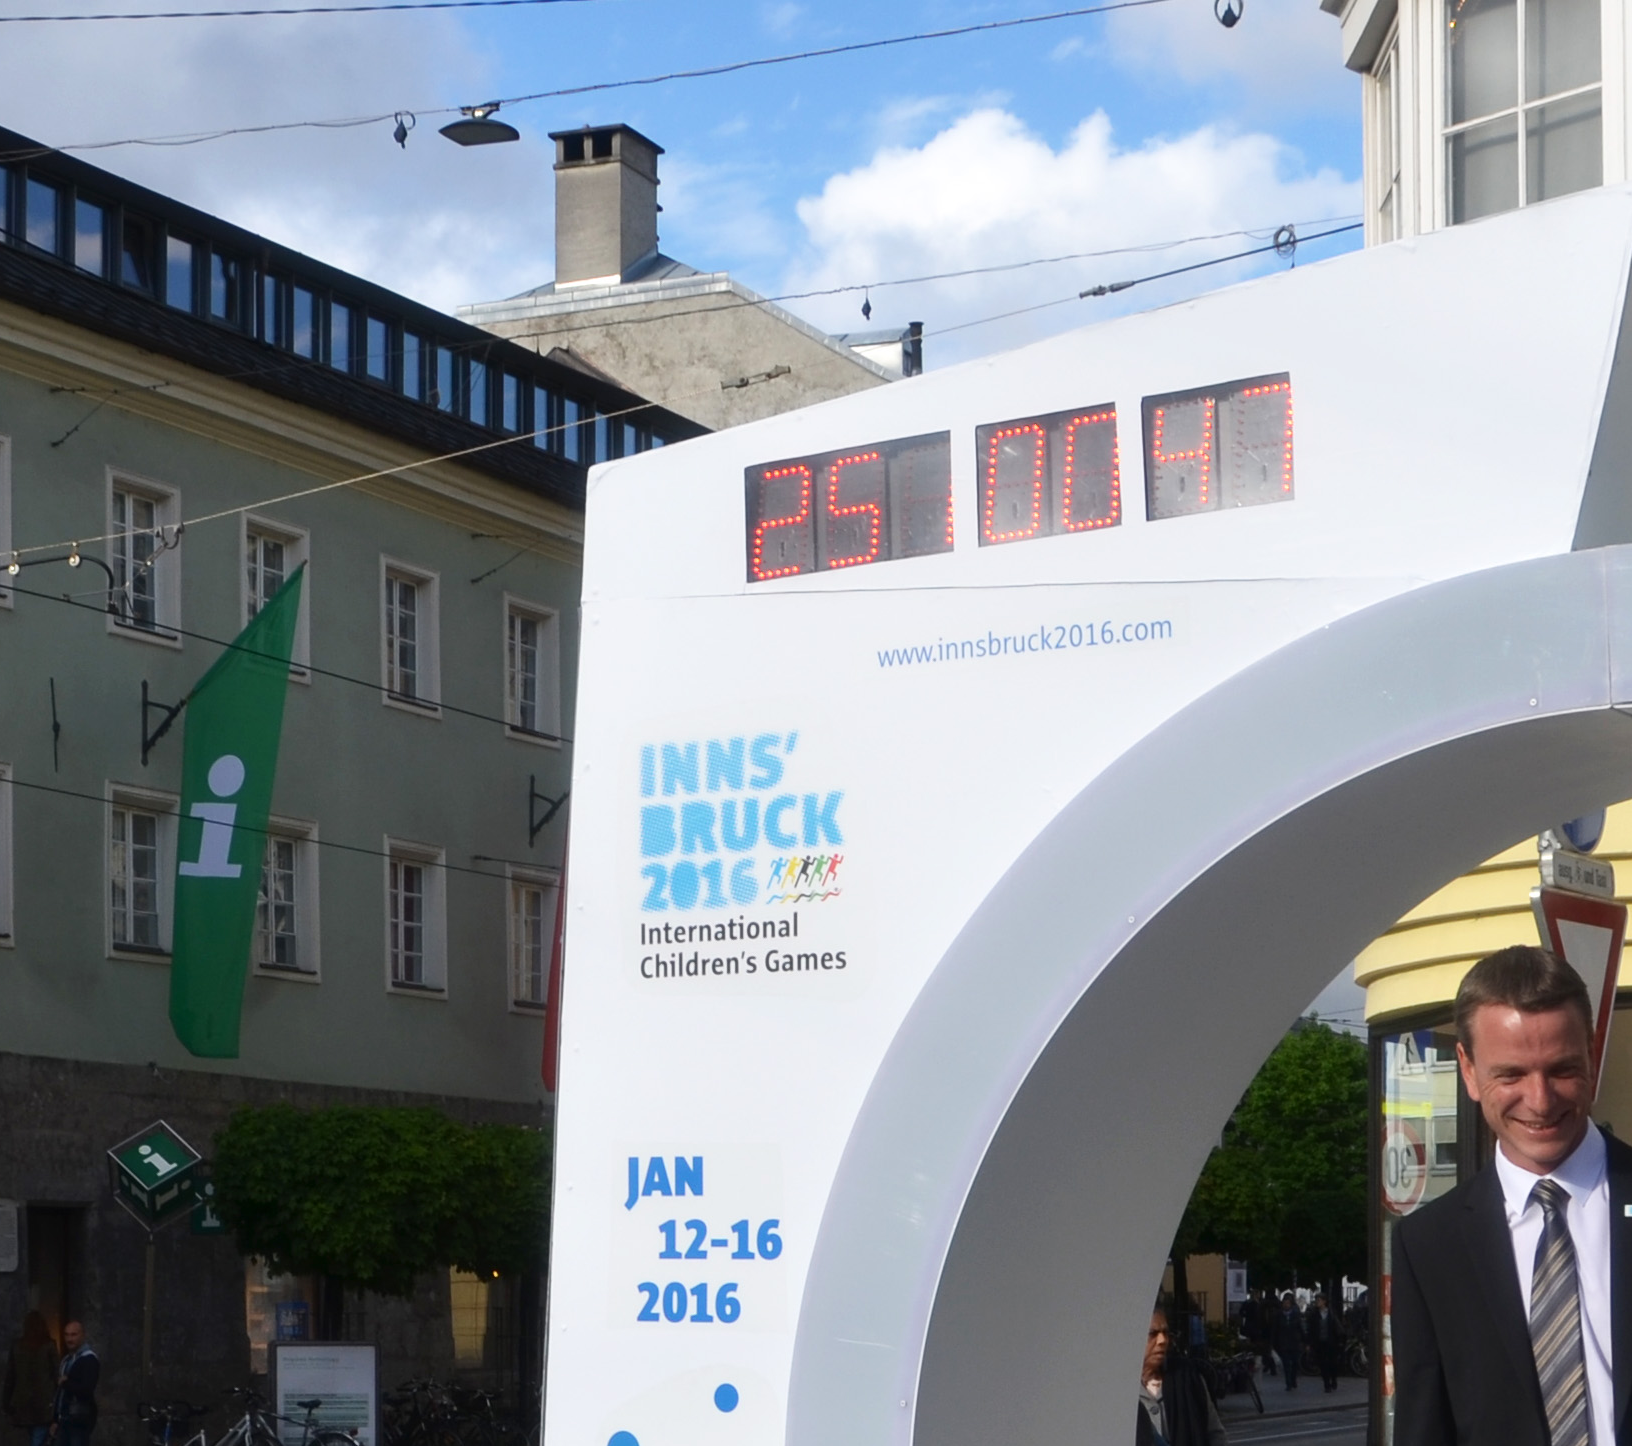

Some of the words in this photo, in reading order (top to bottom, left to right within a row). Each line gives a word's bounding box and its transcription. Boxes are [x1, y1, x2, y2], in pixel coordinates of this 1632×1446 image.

[985, 410, 1120, 542] 00
[1155, 381, 1295, 503] 47
[877, 619, 1173, 668] www.innsbruck2016.com
[639, 789, 846, 858] BRUCK
[639, 856, 760, 913] 2016
[640, 911, 799, 945] International
[640, 950, 758, 979] Children's
[764, 949, 848, 973] Games
[624, 1156, 705, 1210] JAN
[657, 1219, 783, 1260] 12-16
[636, 1282, 742, 1323] 2016
